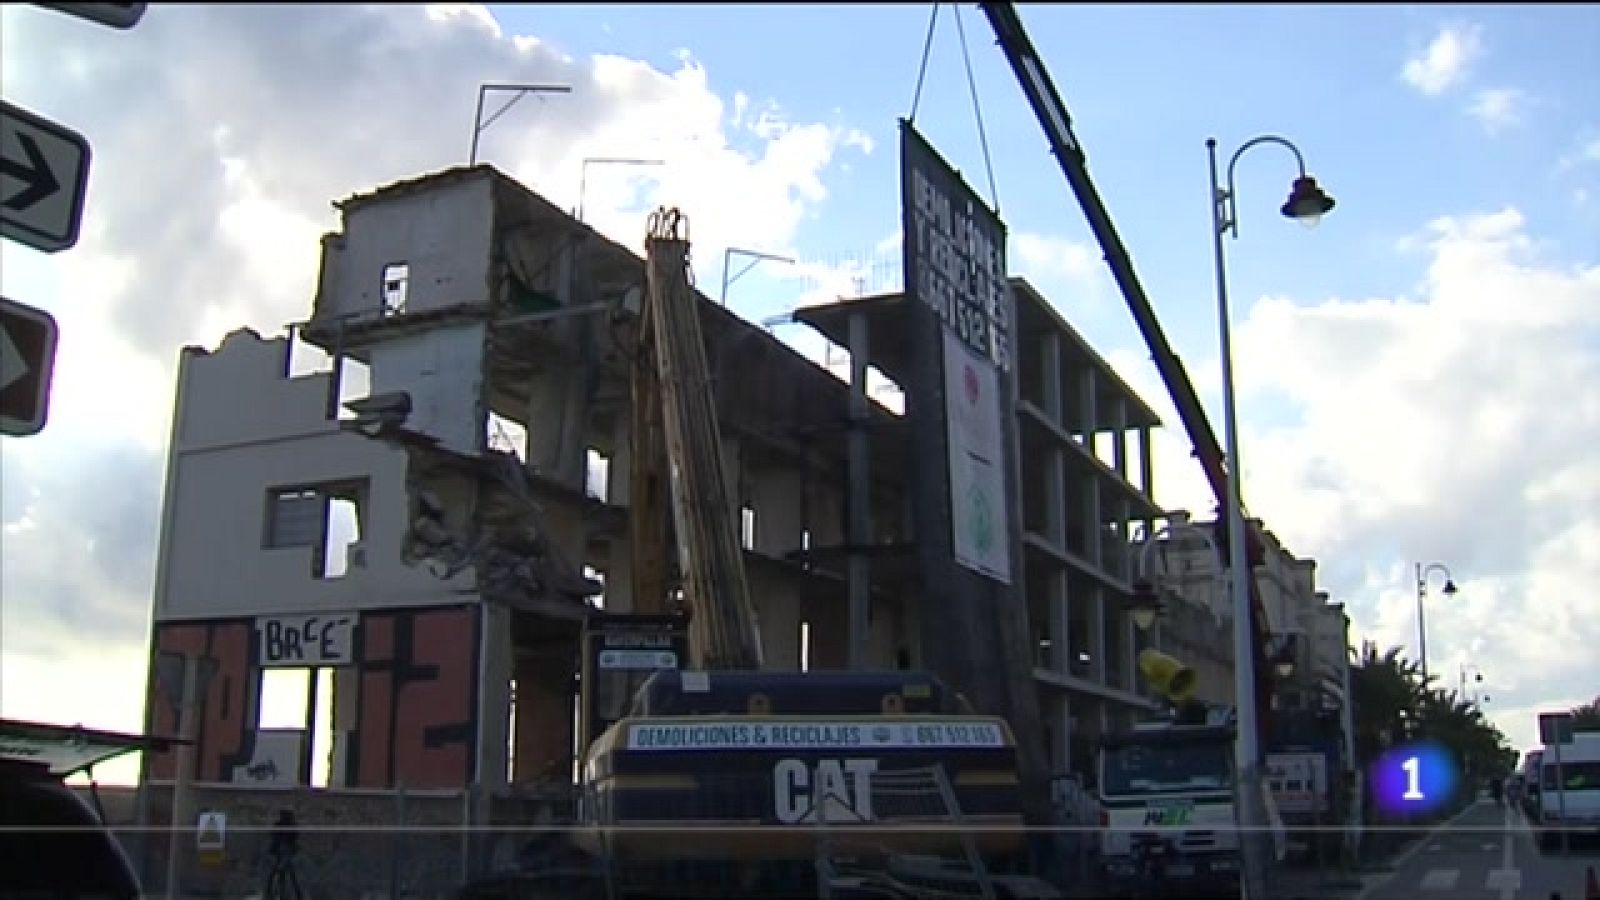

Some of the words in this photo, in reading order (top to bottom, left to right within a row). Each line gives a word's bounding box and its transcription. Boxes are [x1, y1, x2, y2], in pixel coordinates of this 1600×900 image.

[636, 725, 749, 746] DEMOLICIONES
[753, 725, 767, 743] &
[771, 724, 861, 745] RECICLAJES
[774, 758, 879, 824] CAT
